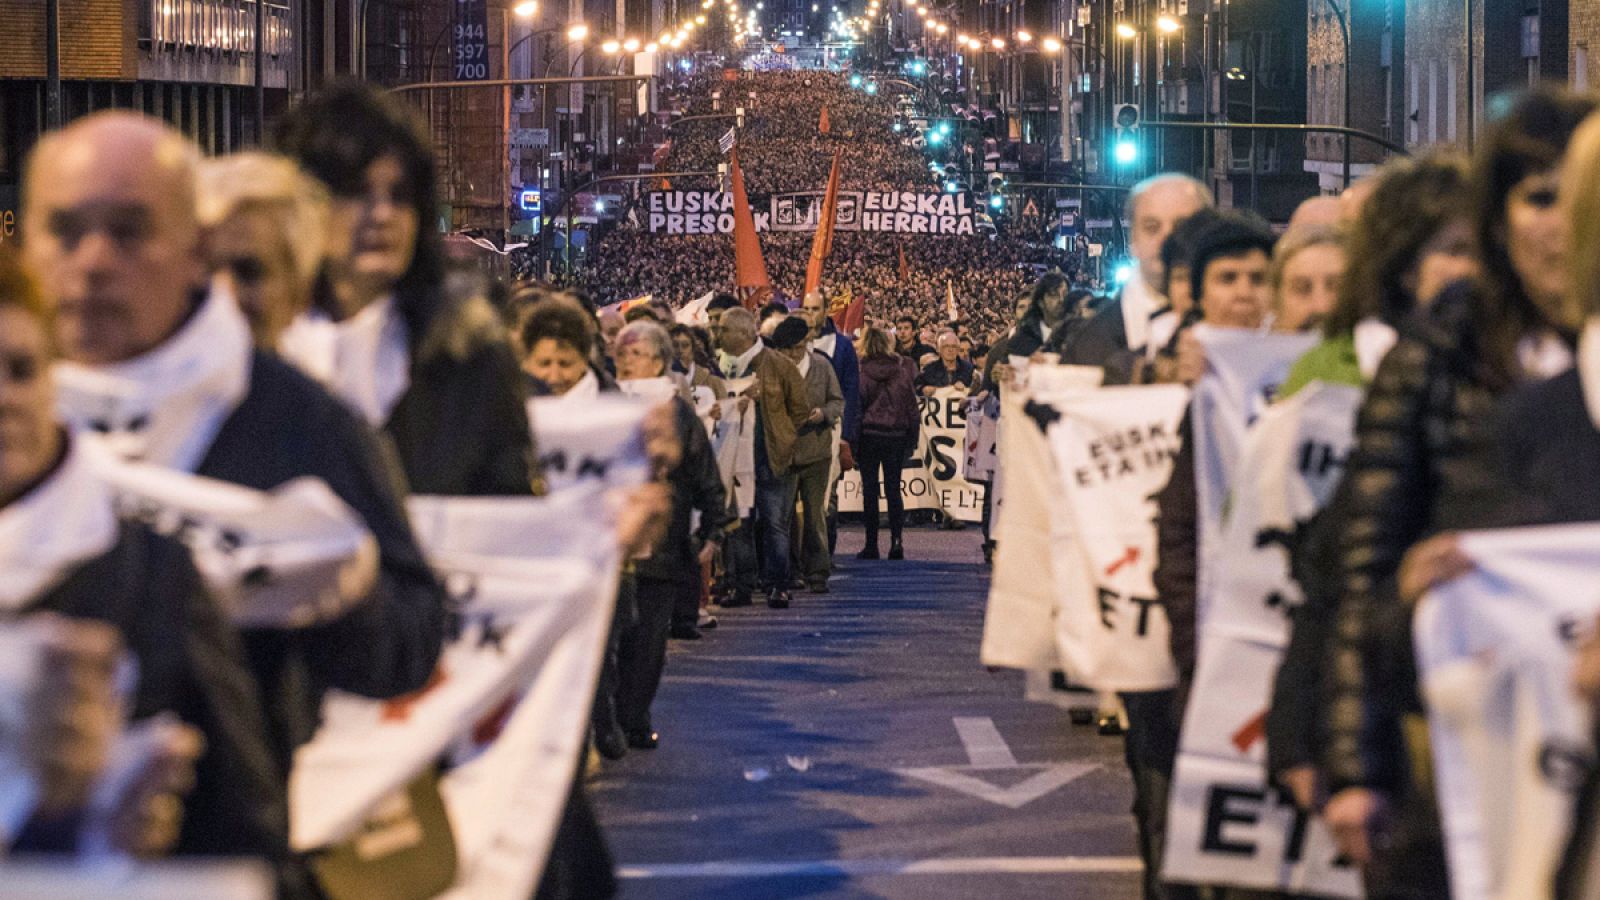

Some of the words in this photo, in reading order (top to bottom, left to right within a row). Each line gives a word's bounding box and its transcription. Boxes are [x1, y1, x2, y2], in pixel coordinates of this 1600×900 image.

[454, 24, 484, 39] 944
[456, 63, 486, 79] 700
[649, 191, 754, 212] EUSKA
[865, 191, 972, 216] EUSKAL
[649, 212, 770, 234] PRESOK
[863, 211, 974, 235] HERRIRA
